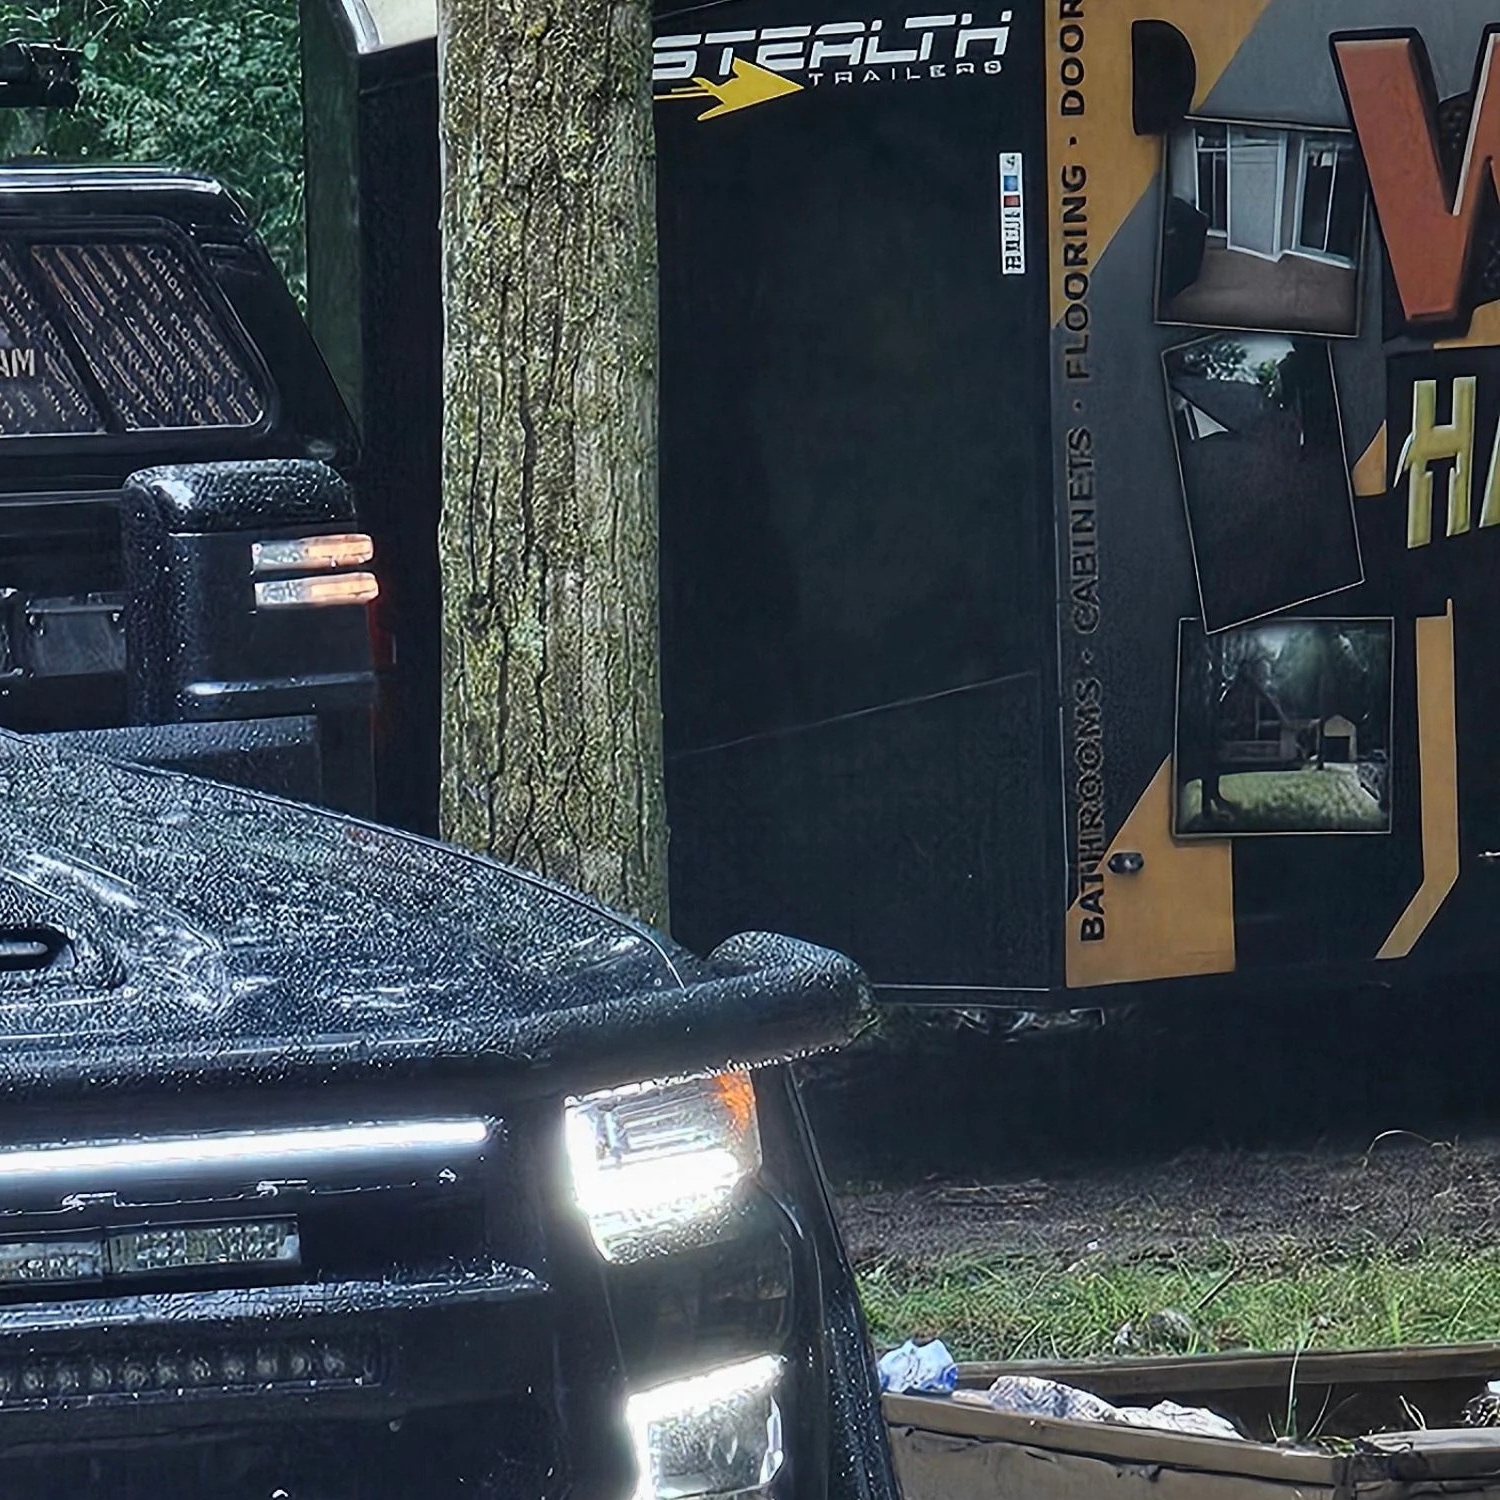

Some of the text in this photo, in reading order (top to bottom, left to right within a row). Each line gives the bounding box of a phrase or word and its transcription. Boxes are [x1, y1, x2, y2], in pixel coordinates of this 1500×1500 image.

[652, 10, 1013, 80] STEALTH
[1062, 164, 1090, 381] FLOORING
[1068, 426, 1100, 634] CABINETS
[1393, 375, 1500, 549] H
[1073, 676, 1105, 942] BATHROOMS
